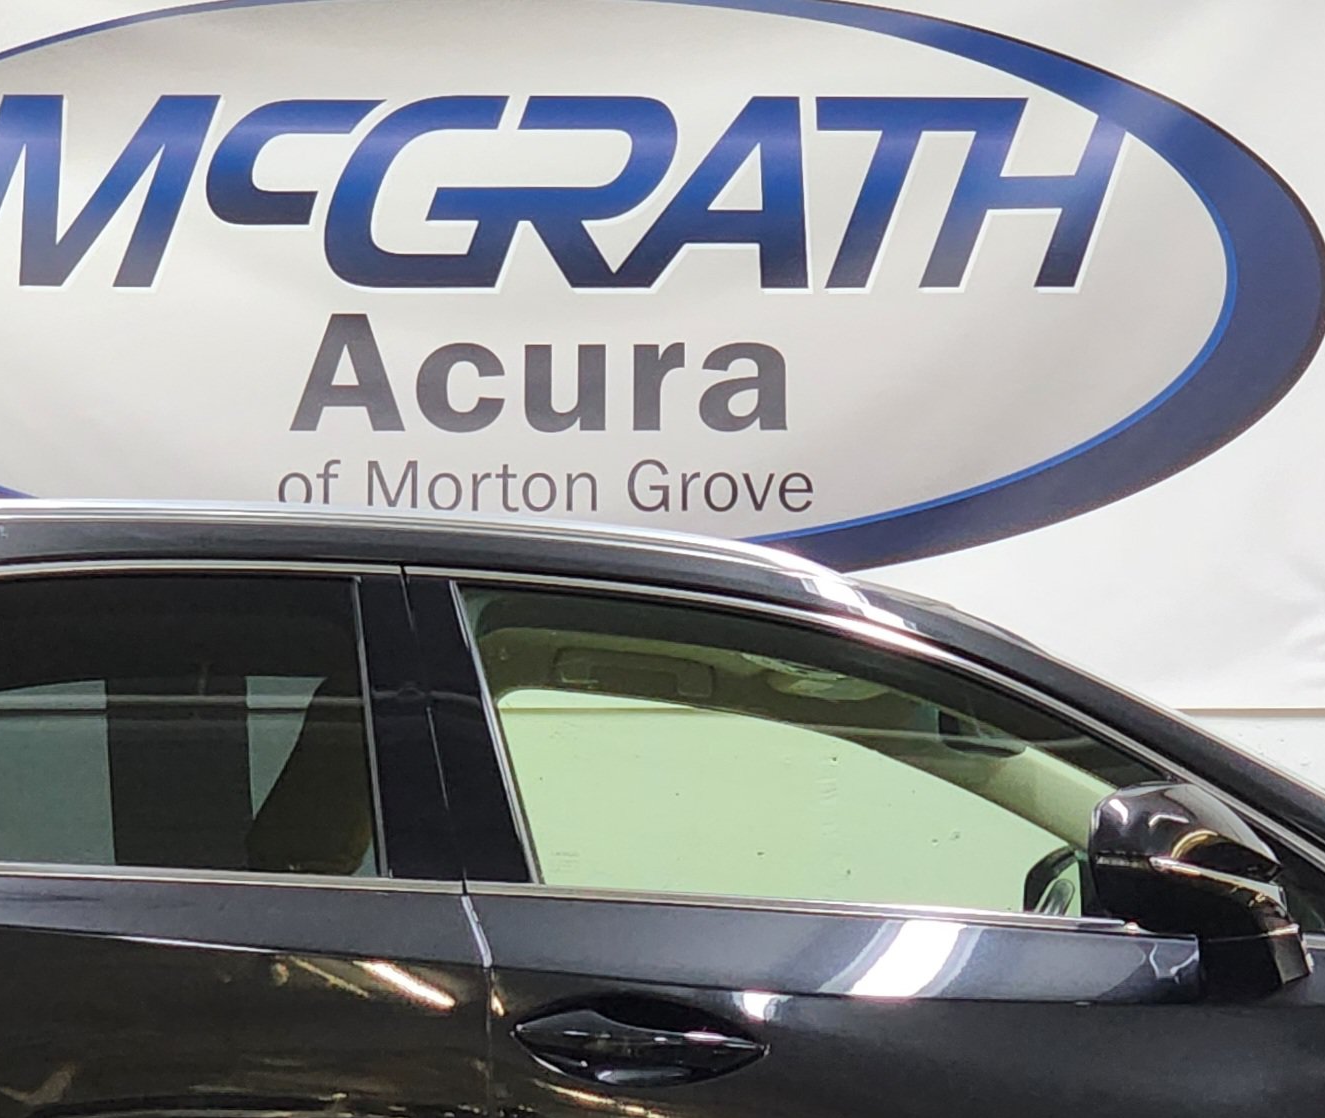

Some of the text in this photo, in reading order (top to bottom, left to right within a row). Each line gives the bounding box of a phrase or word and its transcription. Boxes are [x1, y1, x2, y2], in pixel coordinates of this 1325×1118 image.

[289, 313, 788, 433] Acura
[278, 459, 814, 513] of Morton Grove
